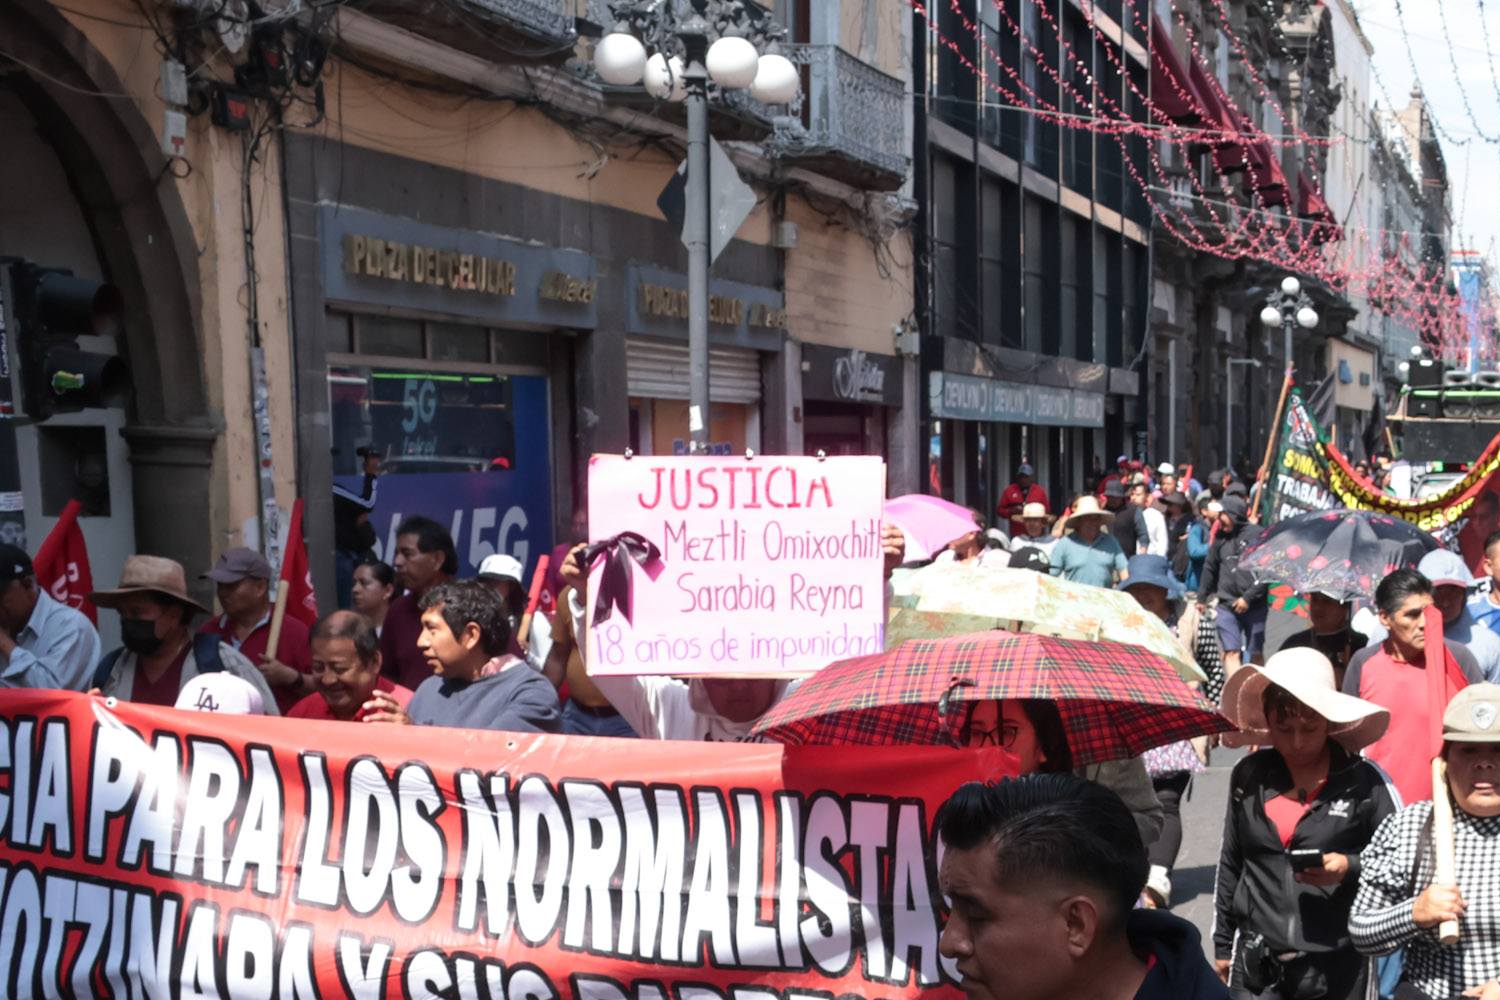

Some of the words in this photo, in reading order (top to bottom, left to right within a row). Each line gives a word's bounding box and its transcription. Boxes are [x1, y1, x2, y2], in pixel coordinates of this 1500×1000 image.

[345, 235, 408, 281] PLAZA
[413, 246, 445, 286] DEL
[451, 252, 516, 296] CELULAR
[402, 379, 437, 433] 5G
[638, 466, 833, 510] JUSTICIA
[664, 519, 745, 562] Meztli
[764, 519, 882, 561] Omixochitl
[677, 572, 775, 612] Sarabia
[790, 573, 864, 617] Reyna
[635, 634, 700, 663] años
[711, 627, 738, 662] de
[193, 687, 219, 711] LA
[85, 722, 283, 898] PARA
[299, 752, 445, 925] LOS
